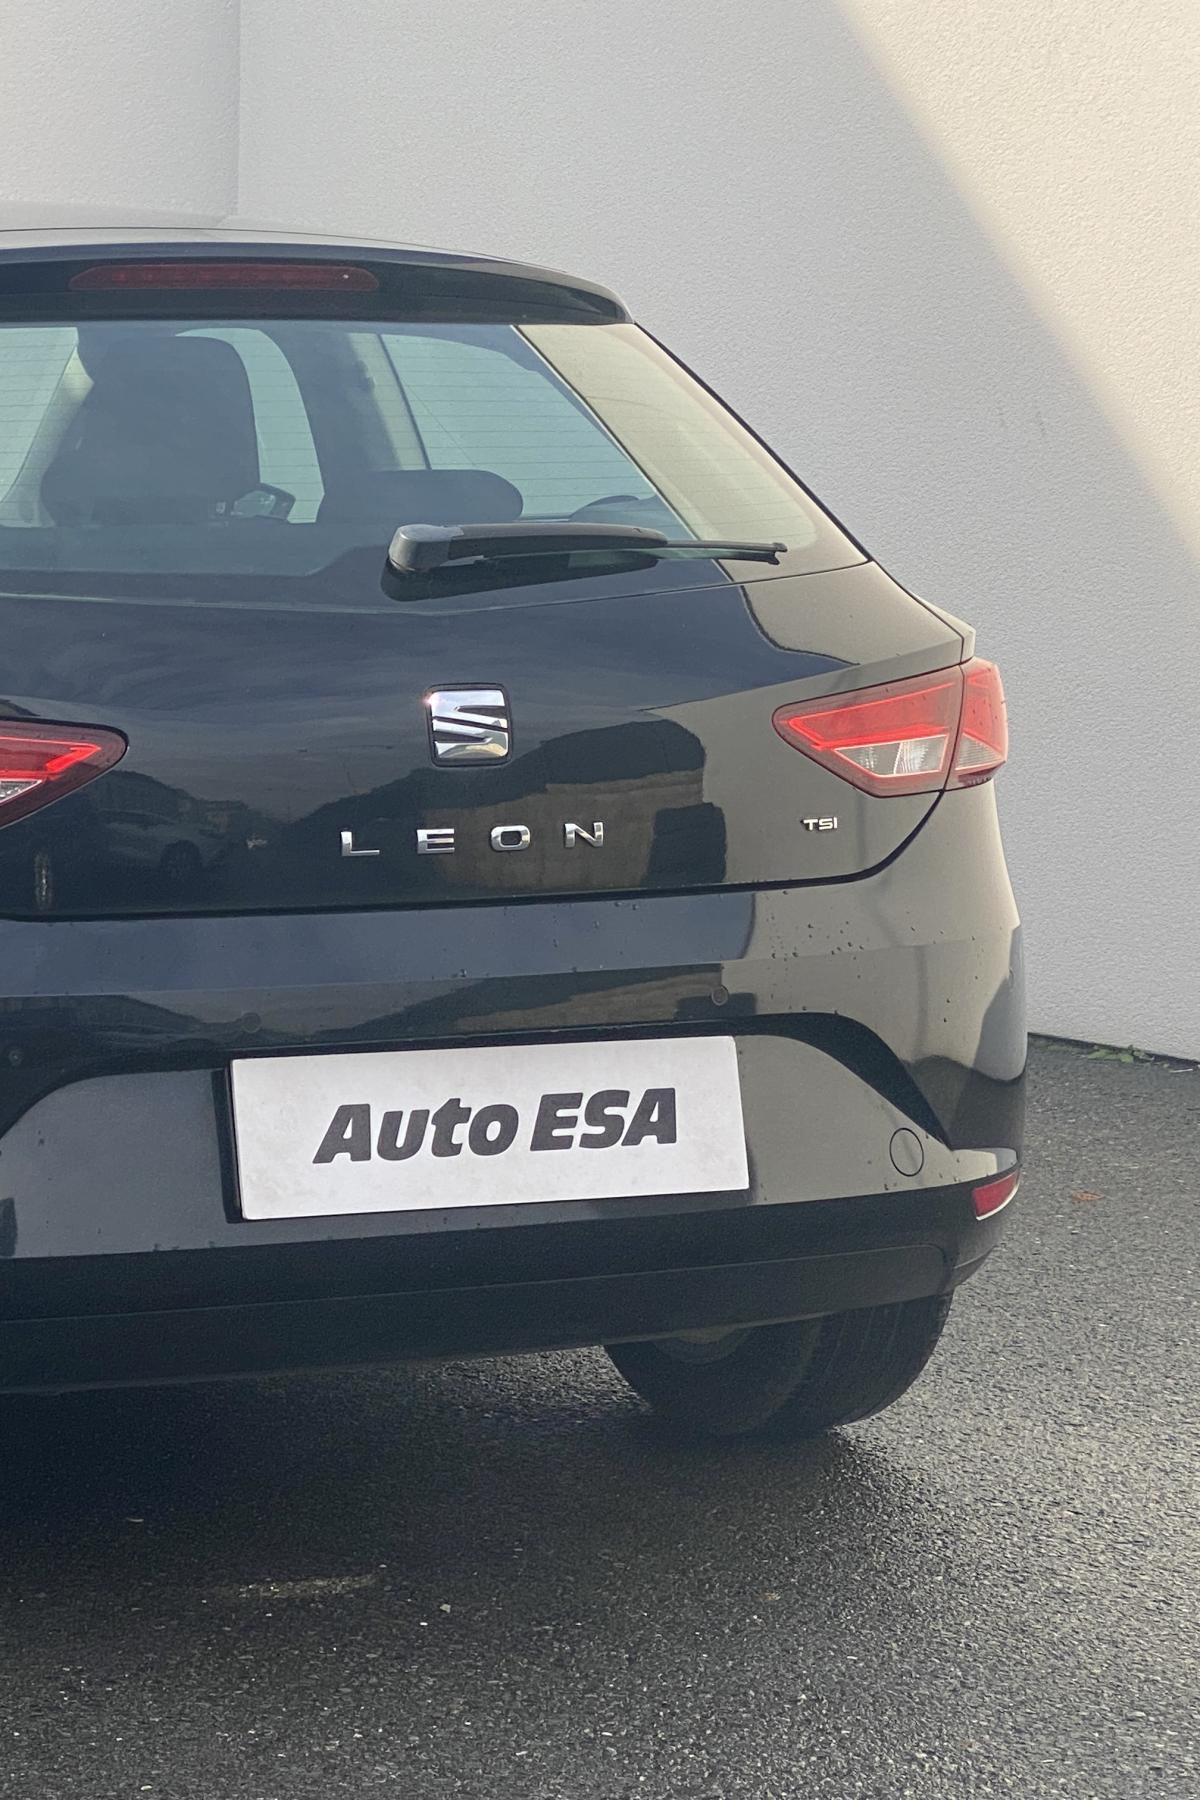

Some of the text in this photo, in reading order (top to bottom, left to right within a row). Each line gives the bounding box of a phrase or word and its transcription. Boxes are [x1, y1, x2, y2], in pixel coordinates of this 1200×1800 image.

[340, 820, 605, 857] LEON
[802, 815, 838, 831] TSI
[312, 1087, 678, 1164] Auto ESA
